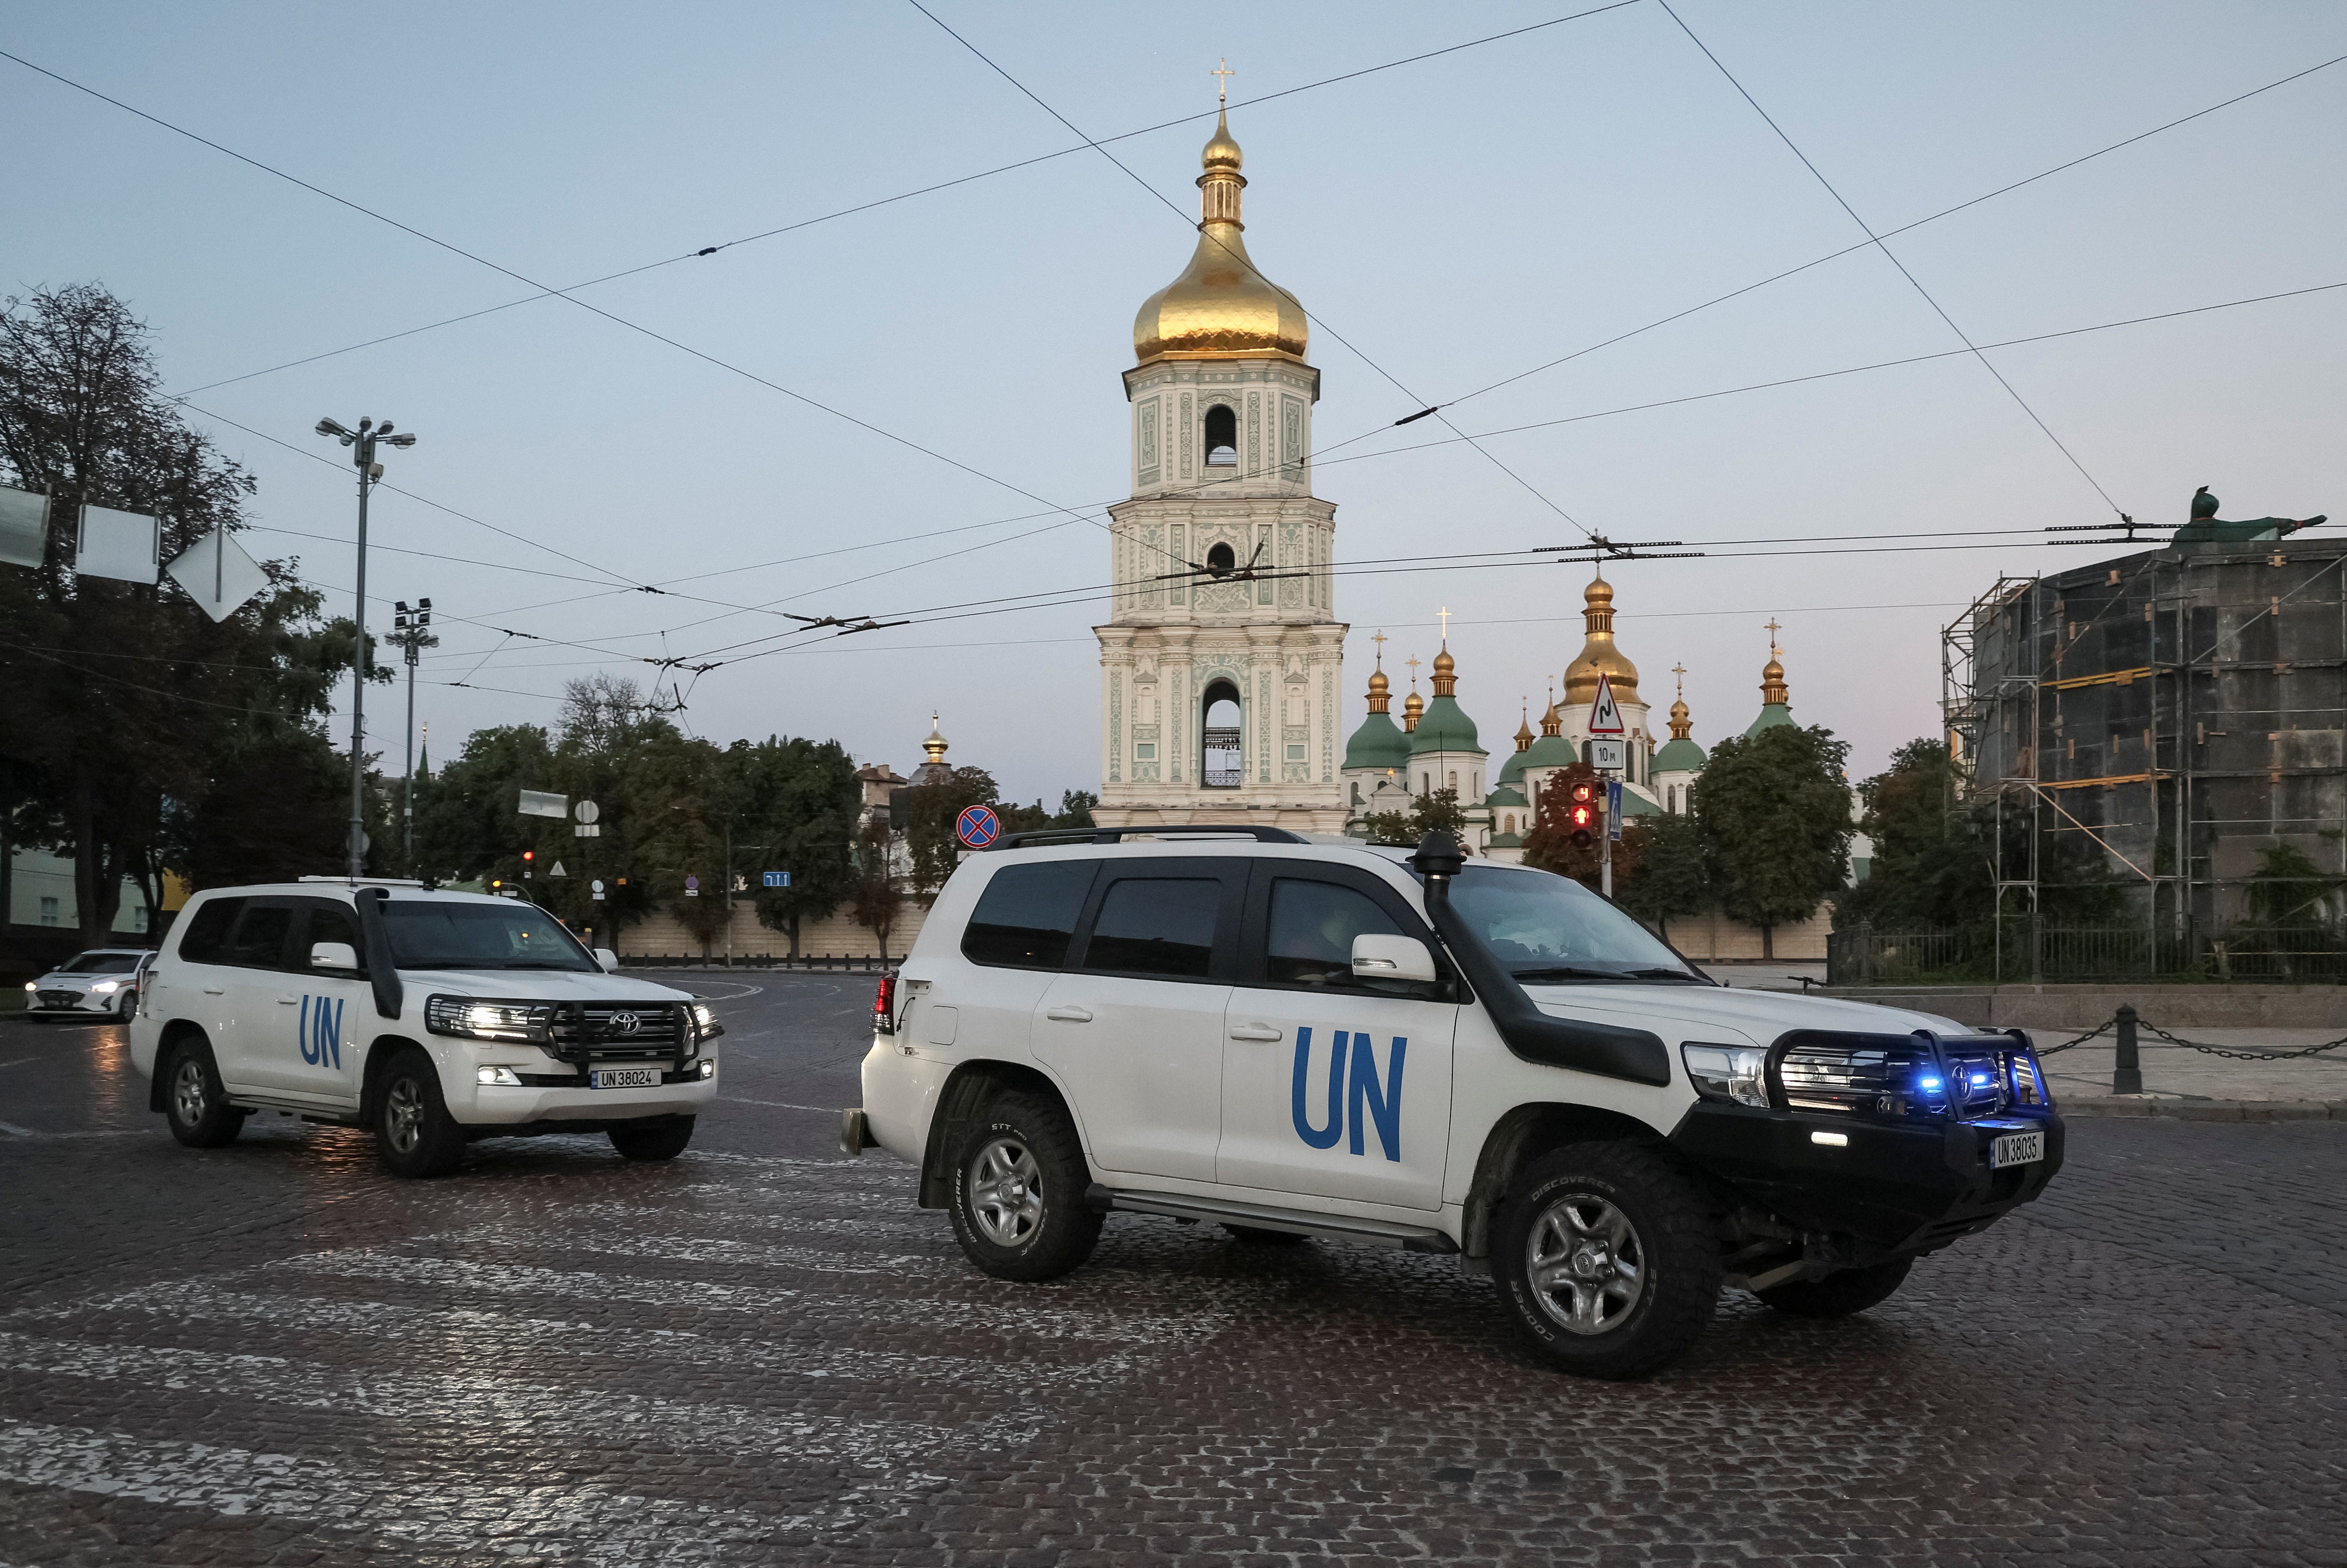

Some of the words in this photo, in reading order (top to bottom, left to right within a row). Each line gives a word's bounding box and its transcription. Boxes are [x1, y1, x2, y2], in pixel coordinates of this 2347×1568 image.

[1598, 747, 1608, 761] 10
[1580, 788, 1588, 798] 4
[300, 994, 344, 1070] UN
[602, 1071, 616, 1086] UN
[618, 1071, 651, 1085] 38024
[1292, 1026, 1408, 1163] UN
[1998, 1139, 2009, 1164] UN
[2011, 1135, 2036, 1161] 38035
[1532, 1176, 1616, 1202] DISCOVERER
[1510, 1280, 1555, 1342] COOPER
